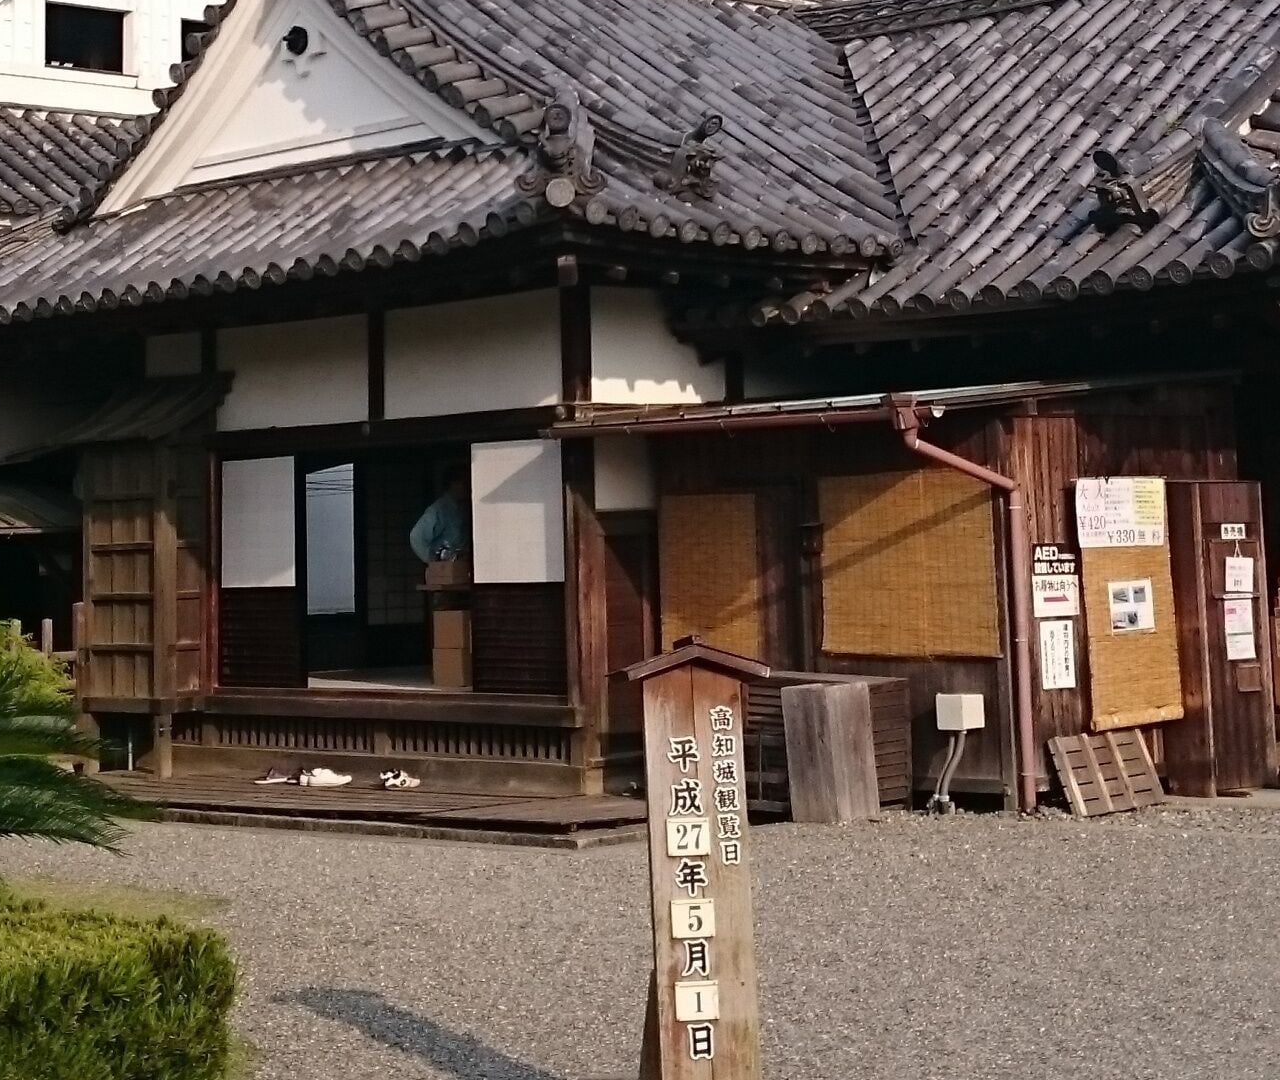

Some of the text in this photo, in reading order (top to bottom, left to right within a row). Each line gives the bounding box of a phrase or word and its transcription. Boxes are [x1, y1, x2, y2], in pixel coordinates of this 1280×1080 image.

[1107, 529, 1136, 544] ¥330
[1034, 546, 1059, 561] AED
[709, 706, 741, 865] 高知城観覧日
